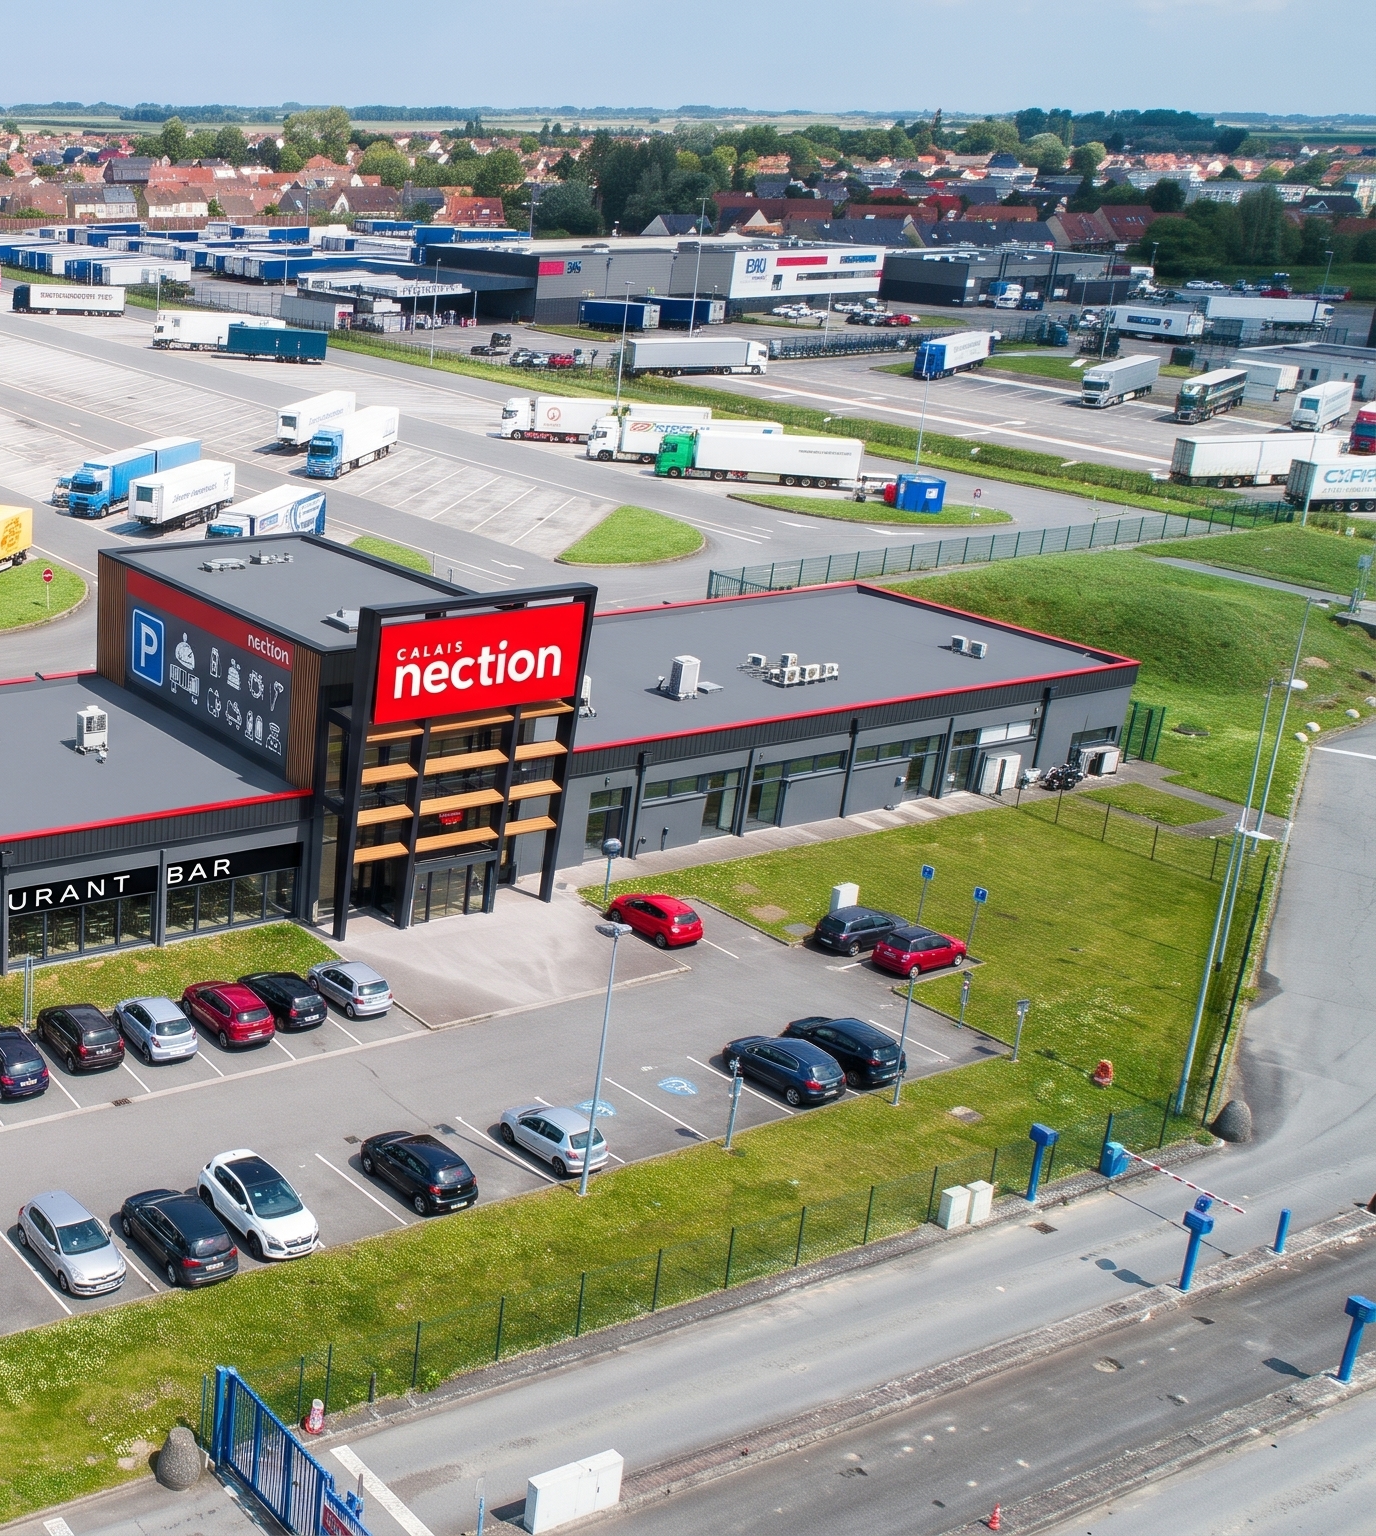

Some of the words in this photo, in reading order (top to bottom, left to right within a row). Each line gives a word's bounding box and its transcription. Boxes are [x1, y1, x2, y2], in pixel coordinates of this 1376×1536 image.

[140, 622, 158, 667] P
[247, 634, 290, 665] nection
[397, 641, 463, 661] CALAIS
[393, 640, 562, 700] nection
[167, 858, 231, 885] BAR
